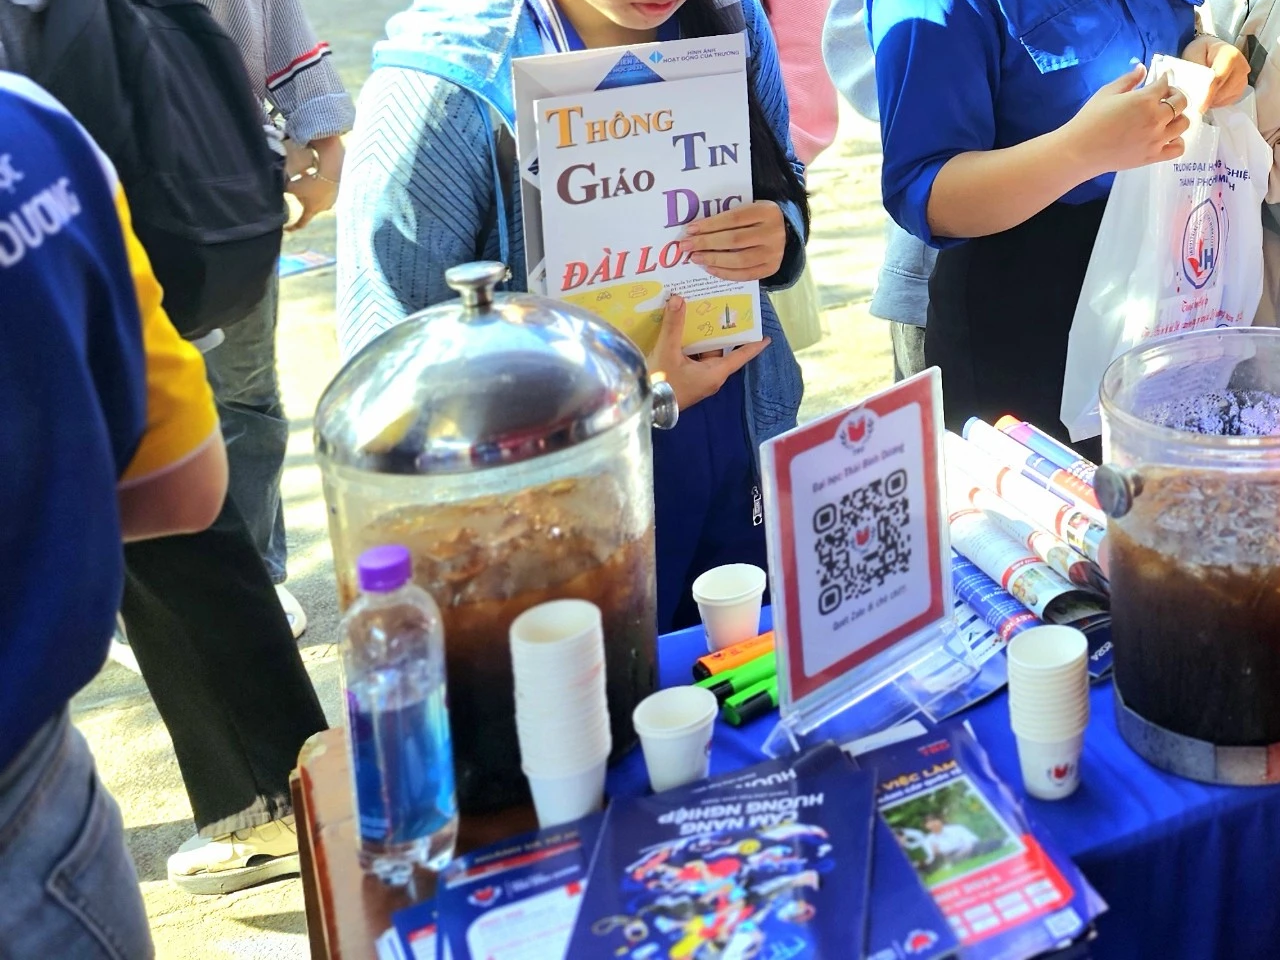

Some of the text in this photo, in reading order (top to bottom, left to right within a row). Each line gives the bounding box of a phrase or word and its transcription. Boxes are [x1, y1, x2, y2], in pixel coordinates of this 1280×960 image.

[545, 105, 739, 172] THÔNG TIN
[557, 162, 656, 206] GIÁO
[561, 246, 631, 291] ĐÀI
[635, 240, 694, 275] LO
